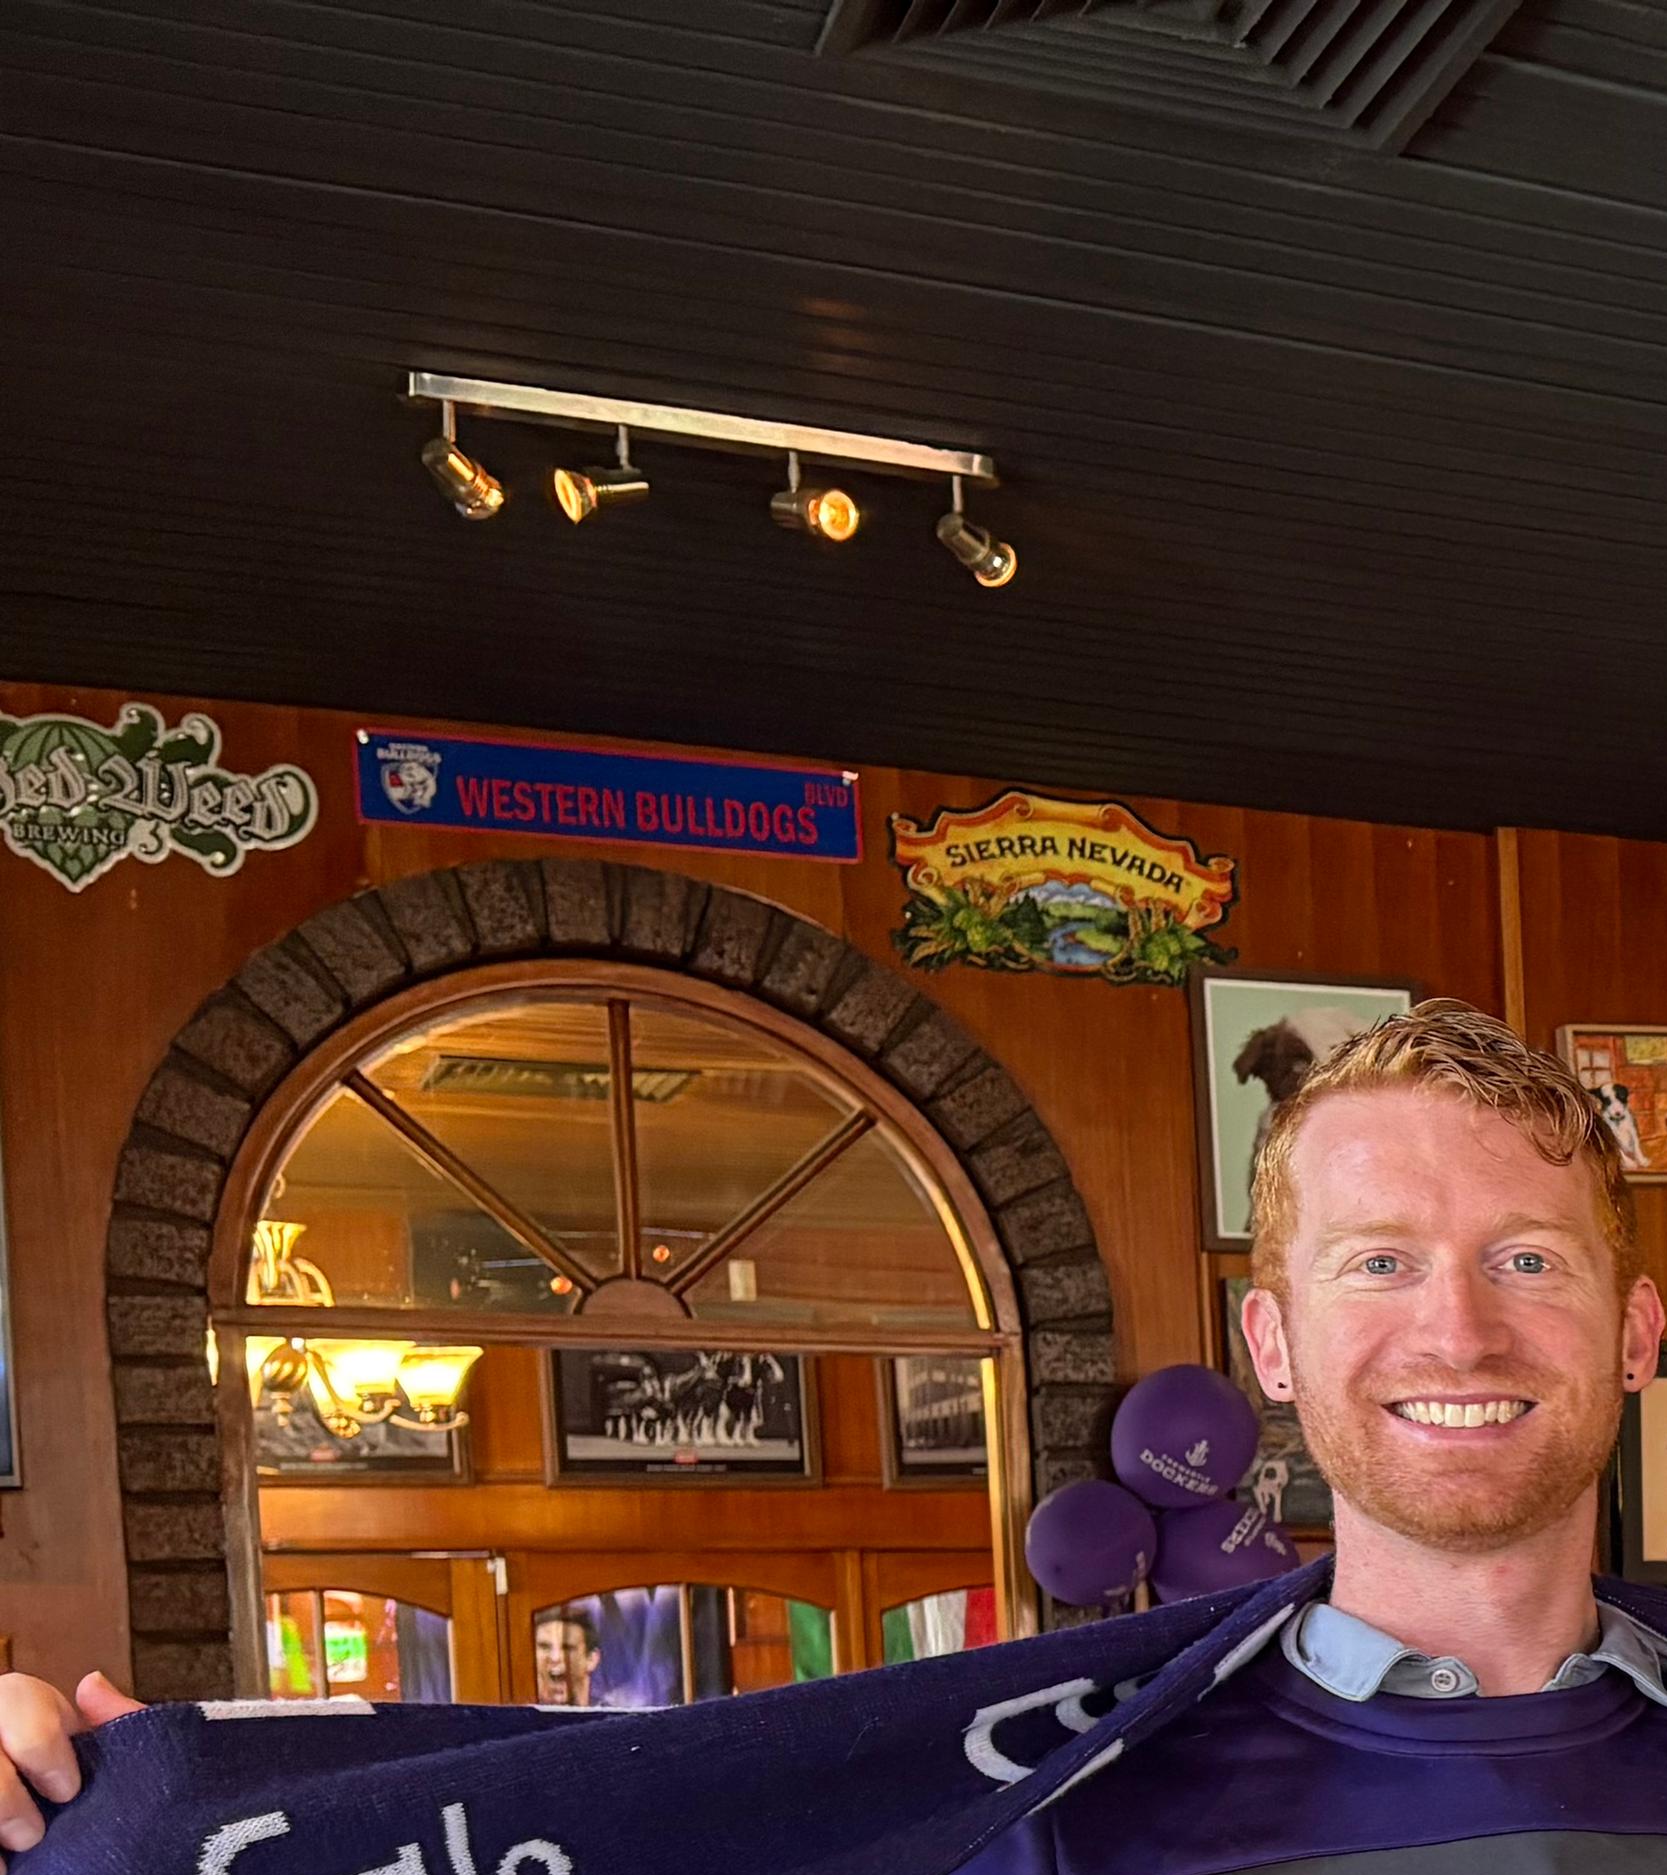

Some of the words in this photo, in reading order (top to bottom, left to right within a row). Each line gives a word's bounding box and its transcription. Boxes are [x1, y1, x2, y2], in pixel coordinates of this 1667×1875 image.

[456, 775, 626, 830] WESTERN
[636, 791, 819, 846] BULLDOGS
[804, 783, 848, 808] BLVD
[13, 822, 126, 846] BREWING
[946, 835, 1060, 867] SIERRA
[1067, 836, 1184, 894] NEVADA
